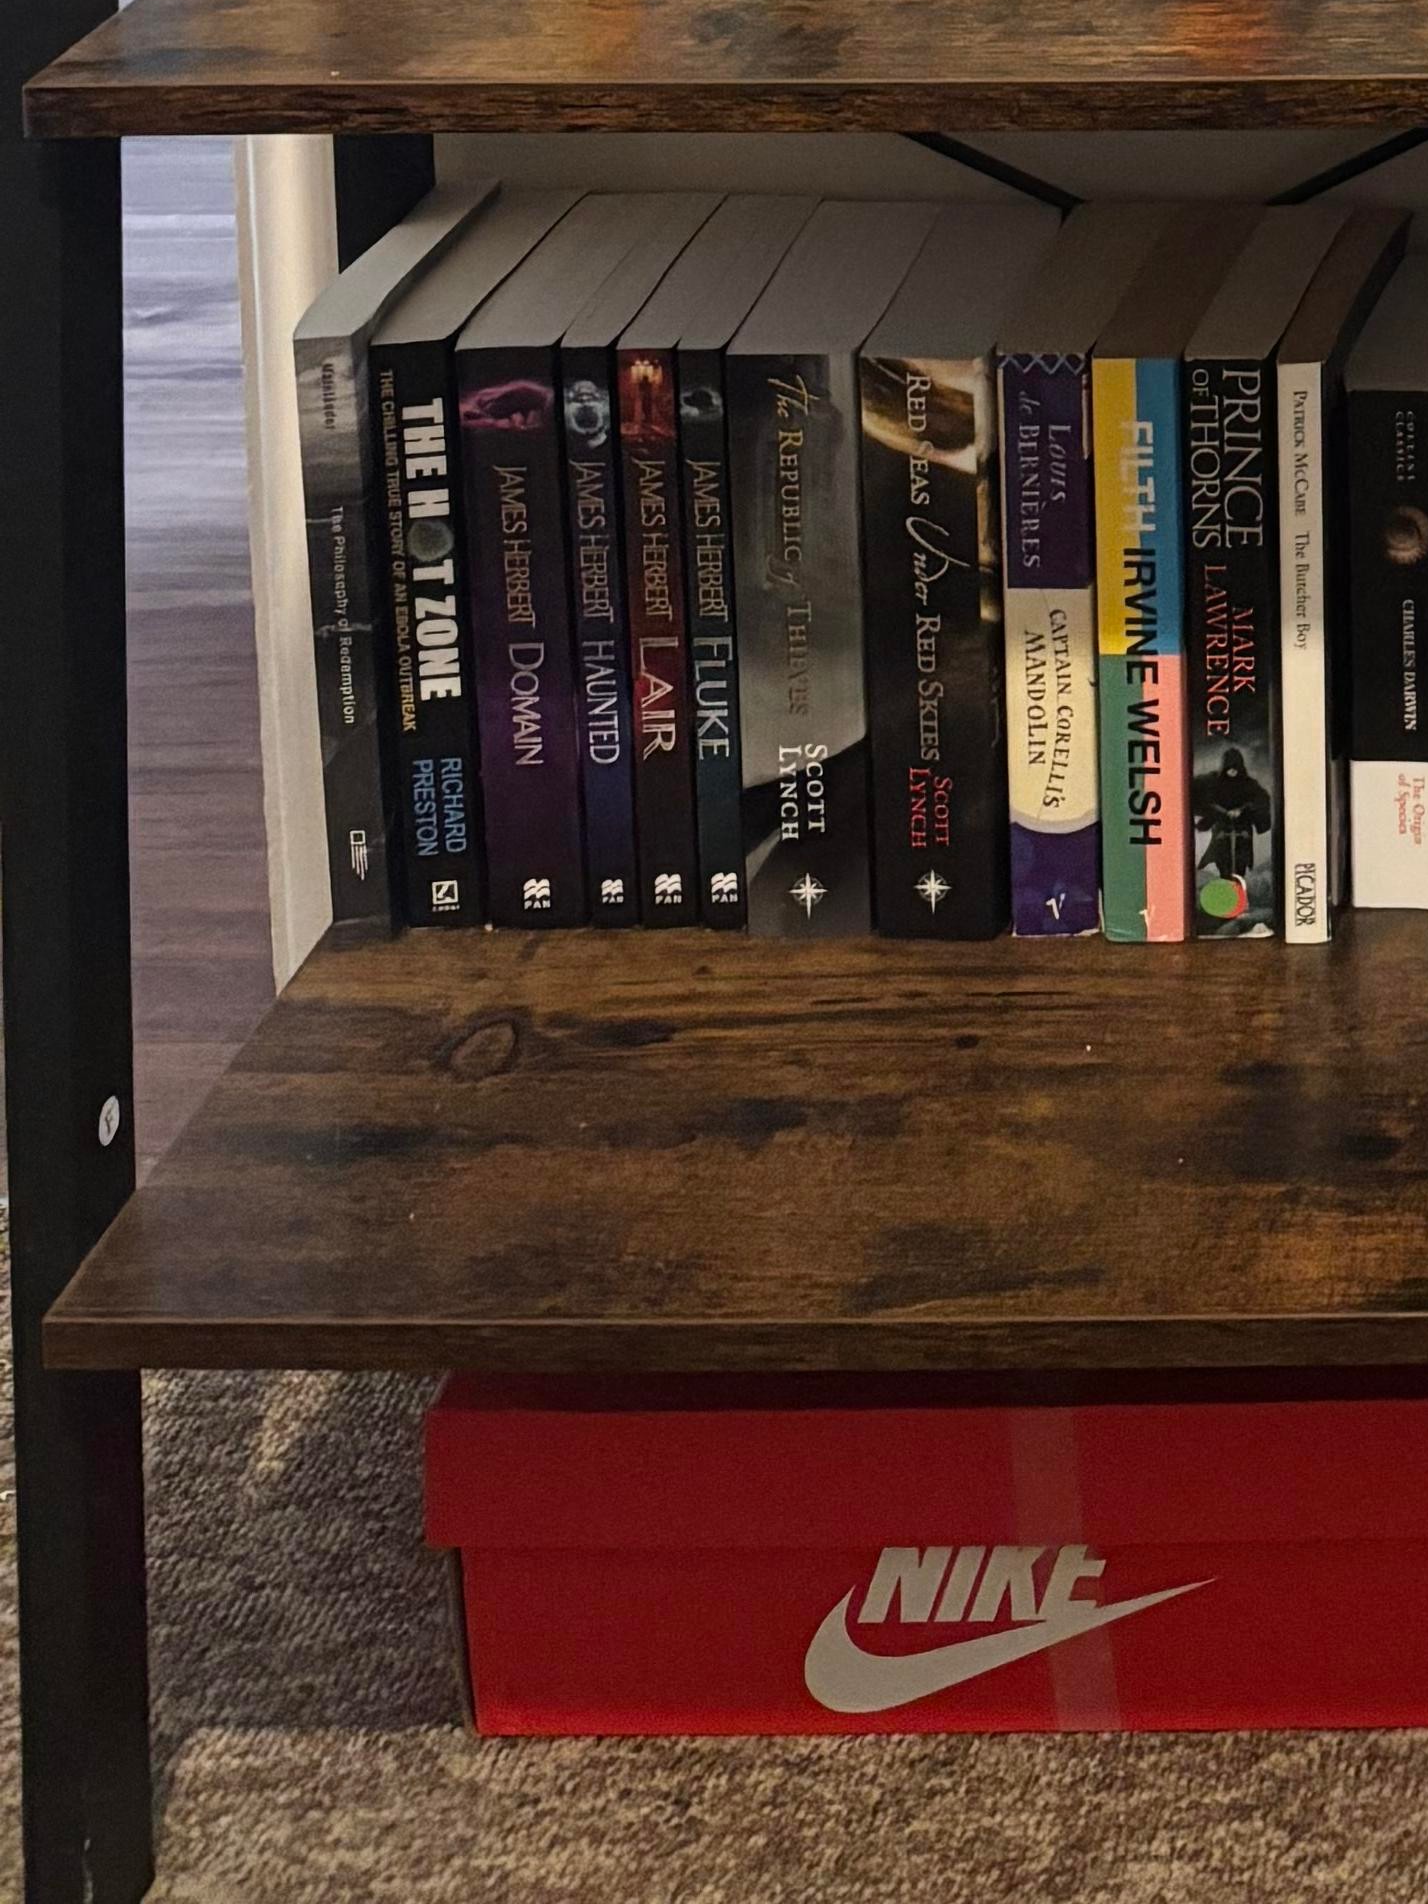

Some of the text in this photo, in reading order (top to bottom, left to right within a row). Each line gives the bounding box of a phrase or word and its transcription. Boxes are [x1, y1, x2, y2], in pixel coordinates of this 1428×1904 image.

[1190, 370, 1221, 549] OF THORNS
[1221, 370, 1262, 547] PRINCE
[1123, 547, 1162, 846] IRVINE WELSH
[413, 759, 437, 858] PRESTON
[440, 758, 465, 854] RICHARD
[778, 745, 799, 841] LYNCH
[804, 743, 827, 833] SCOTT
[857, 1544, 1106, 1623] NIKE
